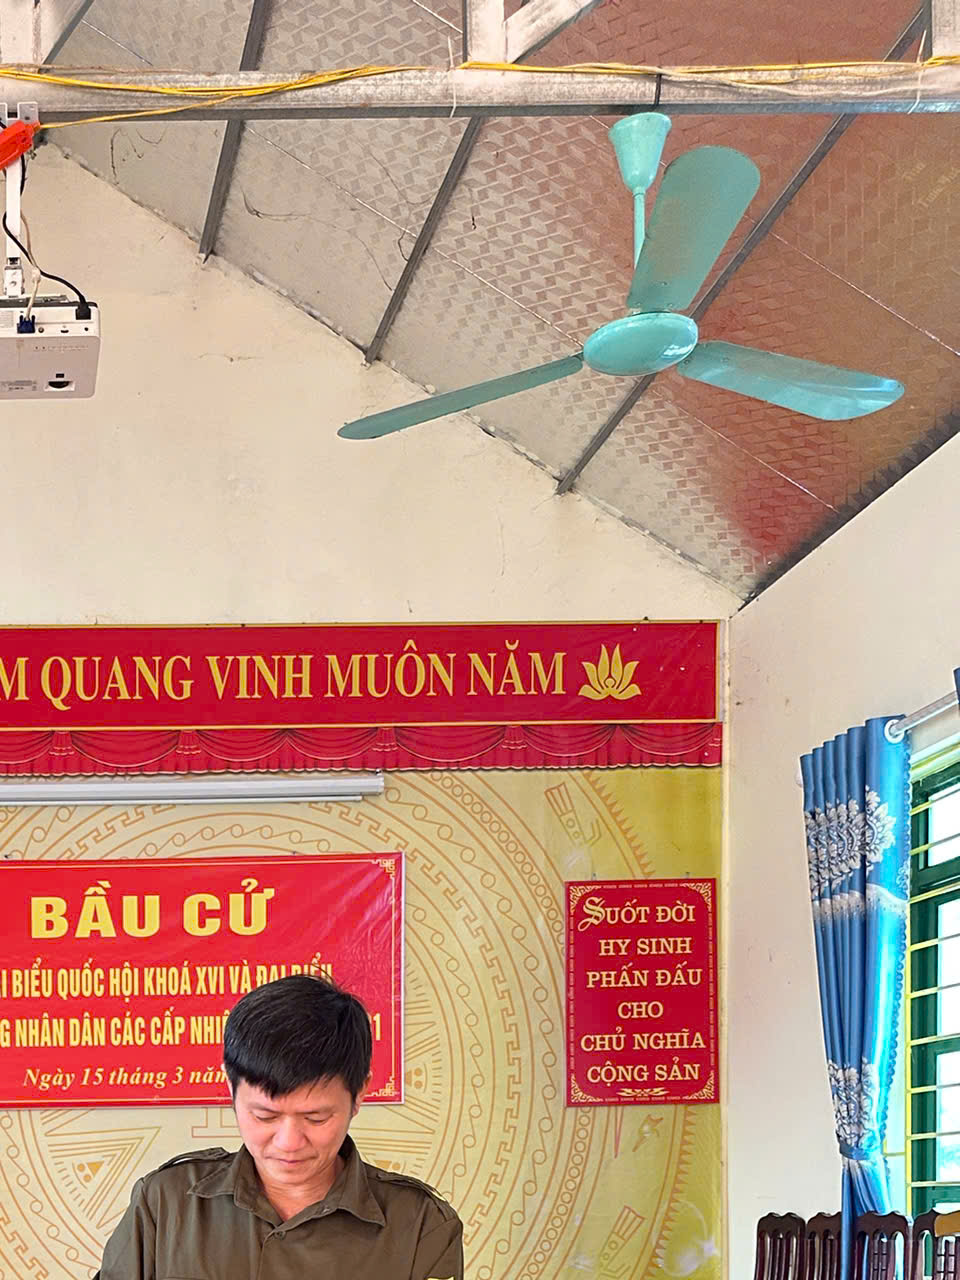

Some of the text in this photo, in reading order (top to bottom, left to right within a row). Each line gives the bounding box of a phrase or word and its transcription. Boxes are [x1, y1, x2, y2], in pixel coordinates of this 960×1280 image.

[41, 656, 195, 712] QUANG
[206, 655, 315, 700] VINH
[324, 640, 457, 698] MUÔN
[467, 640, 567, 697] NĂM
[31, 878, 276, 940] BẦU CỬ
[578, 897, 696, 932] SUỐT ĐỜI
[599, 937, 692, 957] HY SINH
[12, 957, 53, 999] BIỂU
[58, 958, 105, 1001] QUỐC
[110, 962, 139, 1003] HỘI
[145, 961, 191, 996] KHOÁ
[196, 966, 225, 995] XVI
[230, 959, 252, 995] VÀ
[586, 961, 703, 989] PHẤN ĐẤU
[618, 1002, 665, 1020] CHO
[16, 1013, 65, 1048] NHÂN
[70, 1012, 106, 1047] DÂN
[111, 1012, 146, 1046] CÁC
[151, 1006, 186, 1046] CẤP
[581, 1027, 706, 1053] CHỦ NGHĨA
[23, 1068, 76, 1091] Ngày
[82, 1067, 105, 1087] 15
[109, 1067, 168, 1089] tháng
[173, 1067, 184, 1085] 3
[587, 1057, 700, 1088] CỘNG SẢN
